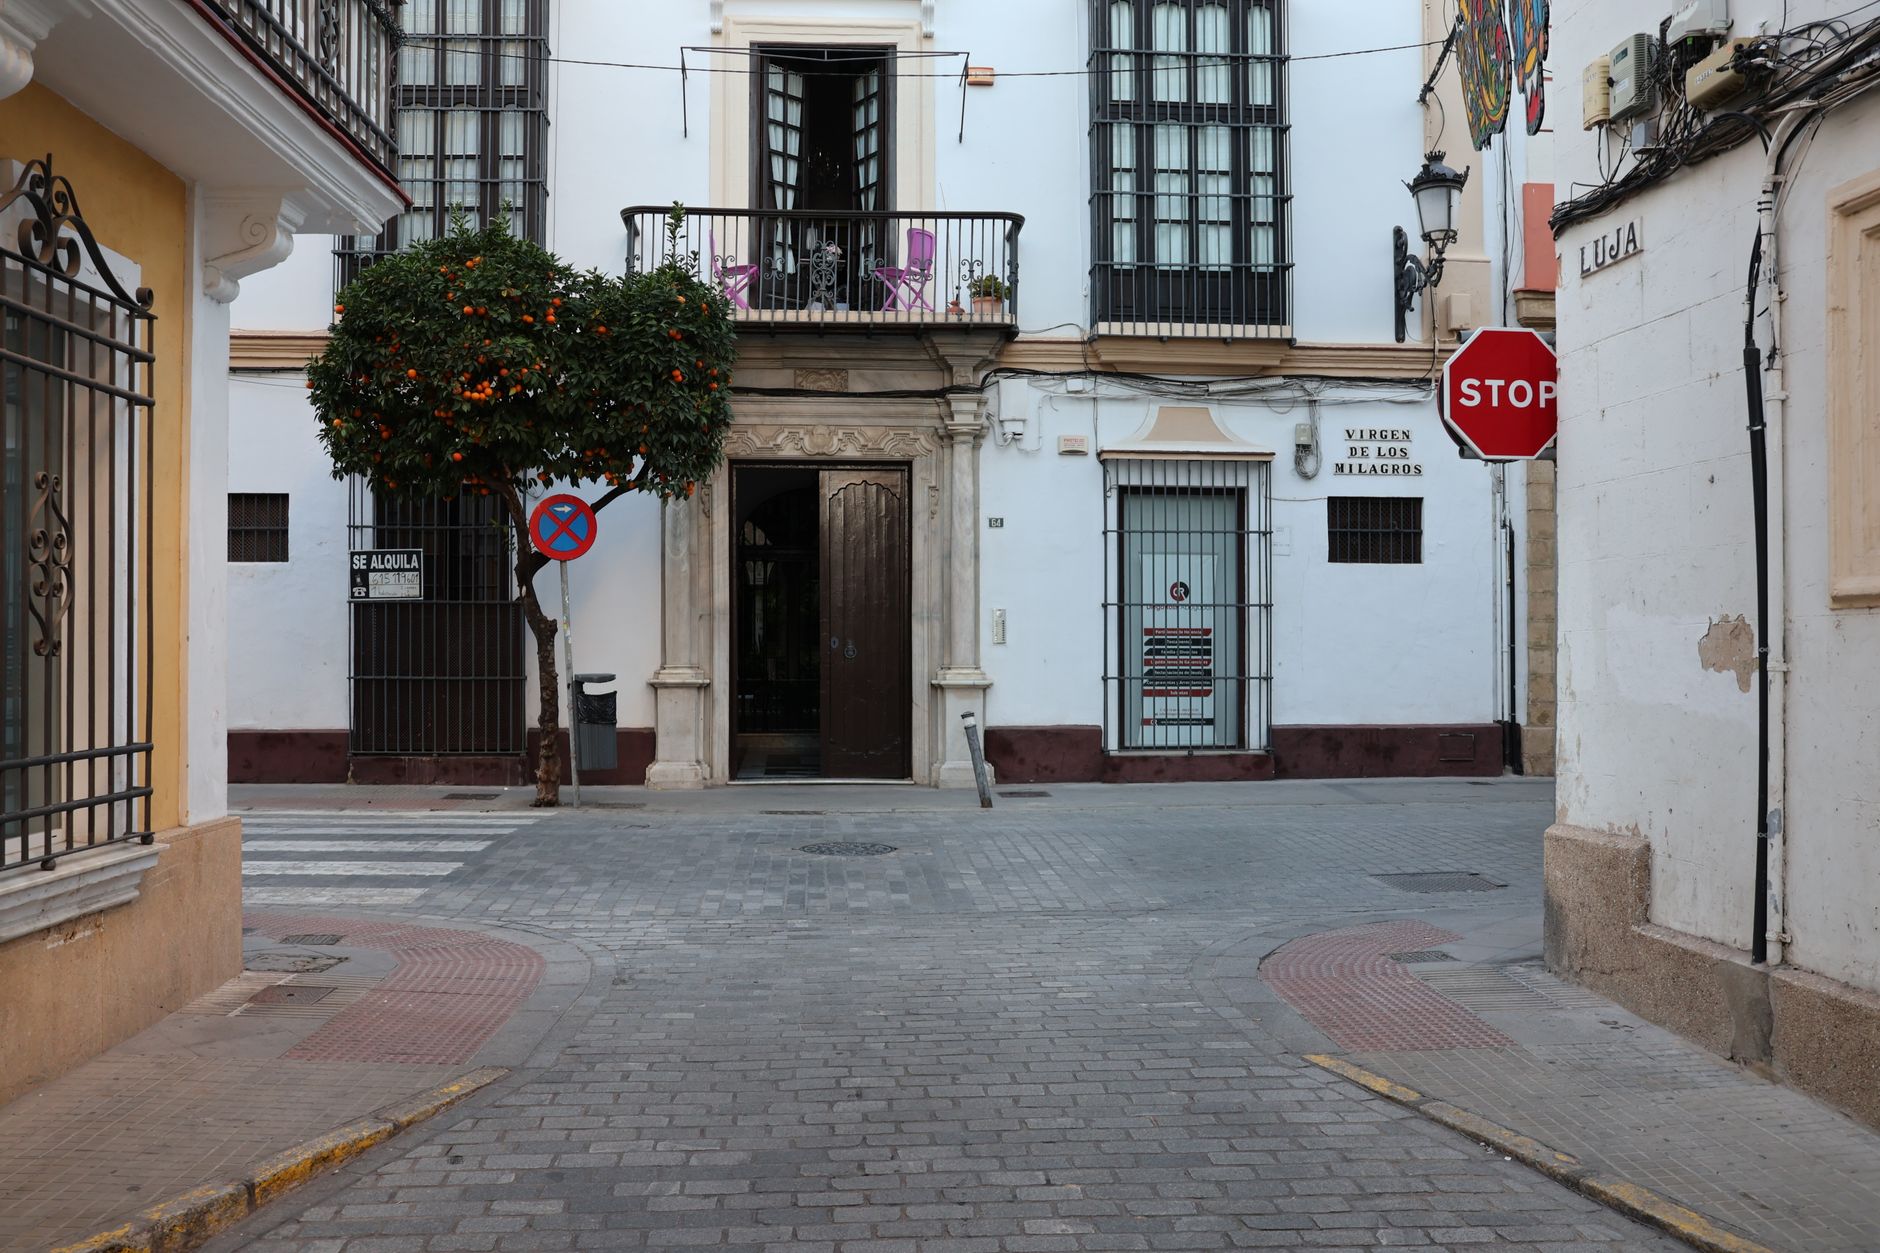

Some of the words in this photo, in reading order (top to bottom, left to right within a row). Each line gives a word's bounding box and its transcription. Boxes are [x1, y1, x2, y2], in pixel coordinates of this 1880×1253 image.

[1580, 221, 1638, 275] LUJA
[1459, 378, 1557, 408] STOP
[1345, 429, 1410, 440] VIRGEN
[1349, 446, 1369, 457] DE
[1377, 446, 1408, 457] LOS
[1335, 463, 1422, 475] MILAGROS
[991, 518, 1001, 527] 64
[352, 554, 367, 570] SE
[370, 554, 419, 570] ALQUILA
